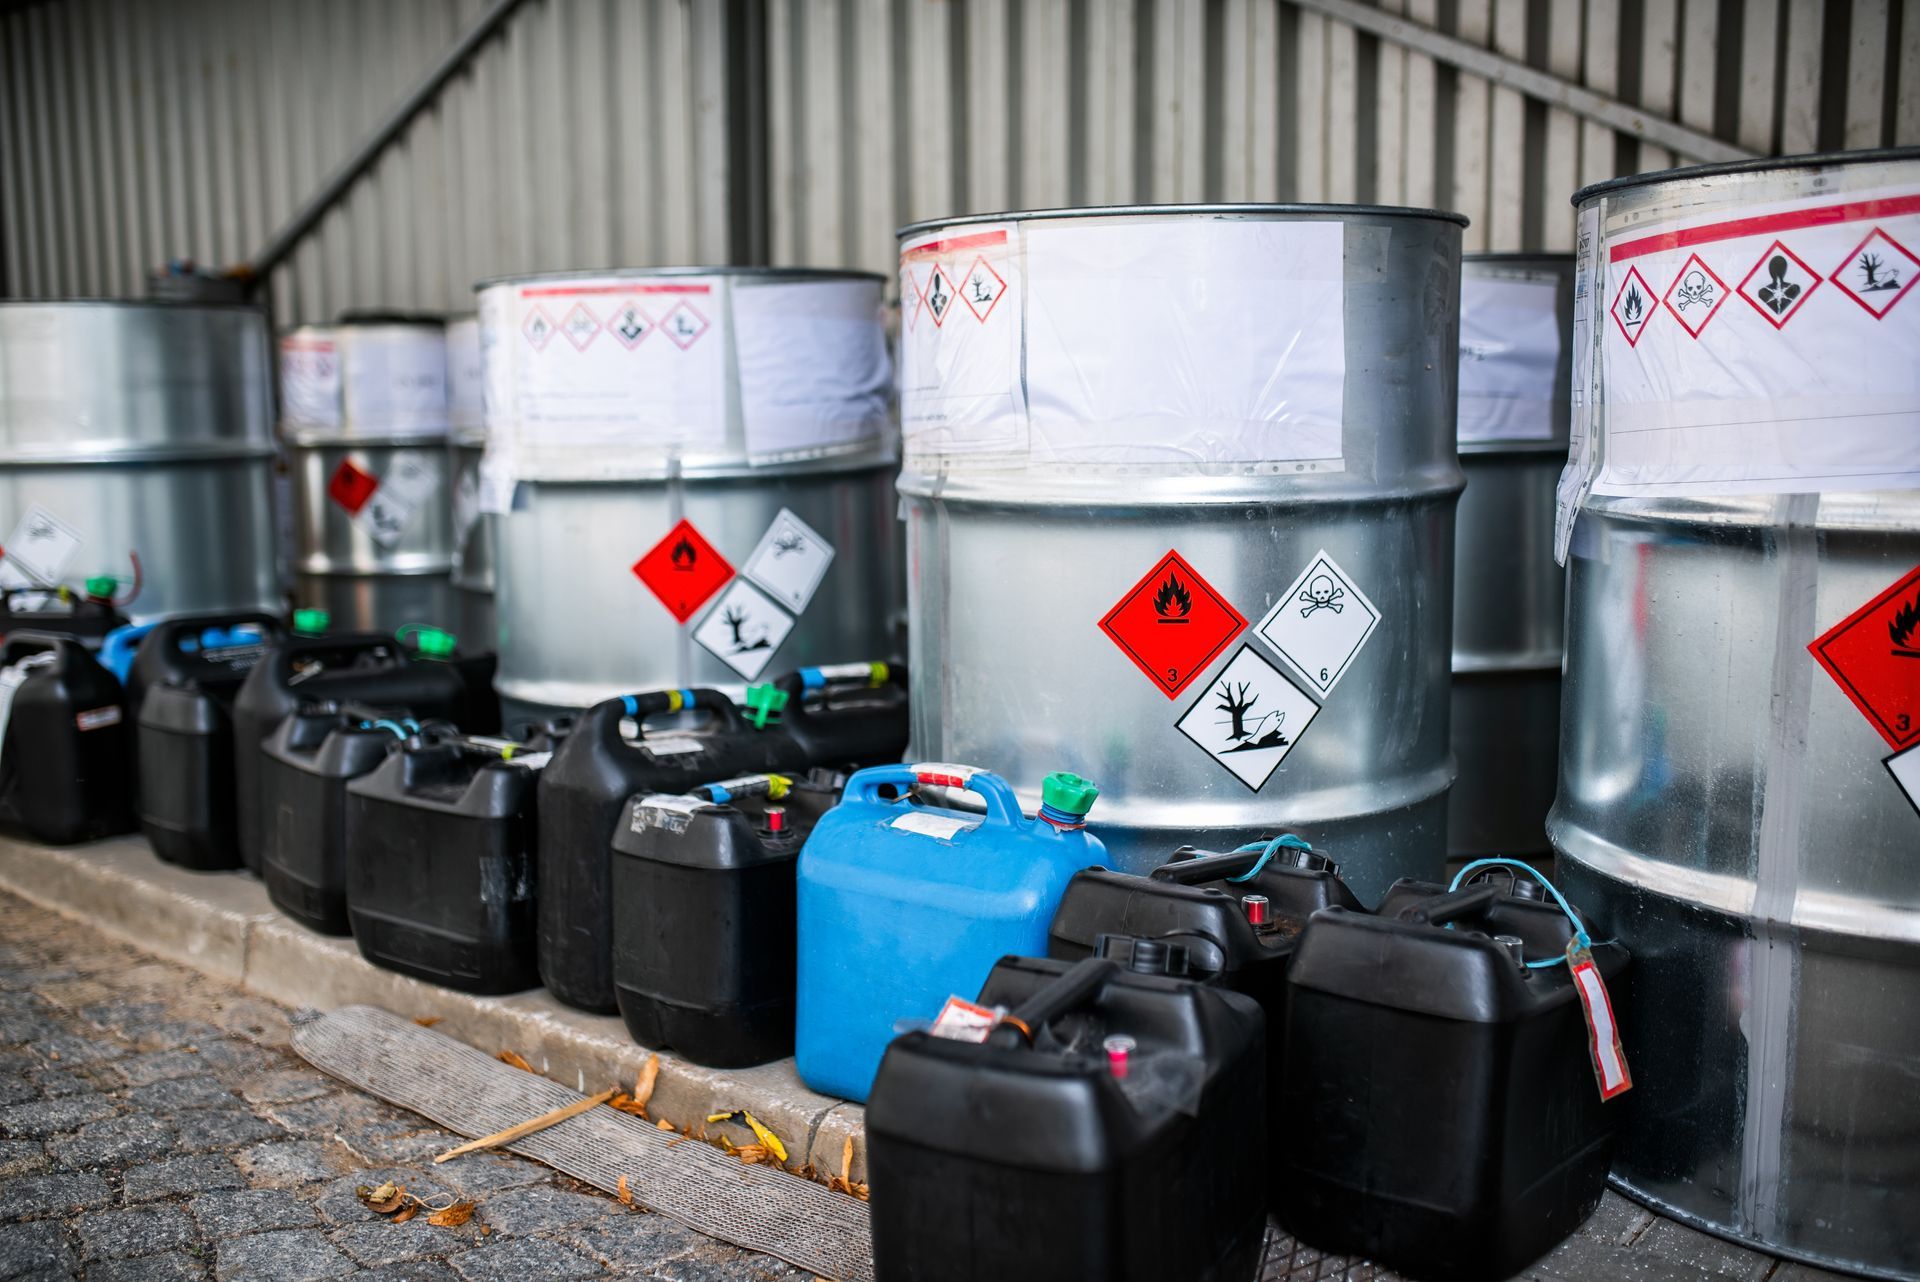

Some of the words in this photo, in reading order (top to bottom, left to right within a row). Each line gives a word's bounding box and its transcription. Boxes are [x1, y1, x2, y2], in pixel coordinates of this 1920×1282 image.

[1167, 668, 1178, 682] 3
[1320, 667, 1328, 681] 6
[1895, 713, 1910, 731] 3
